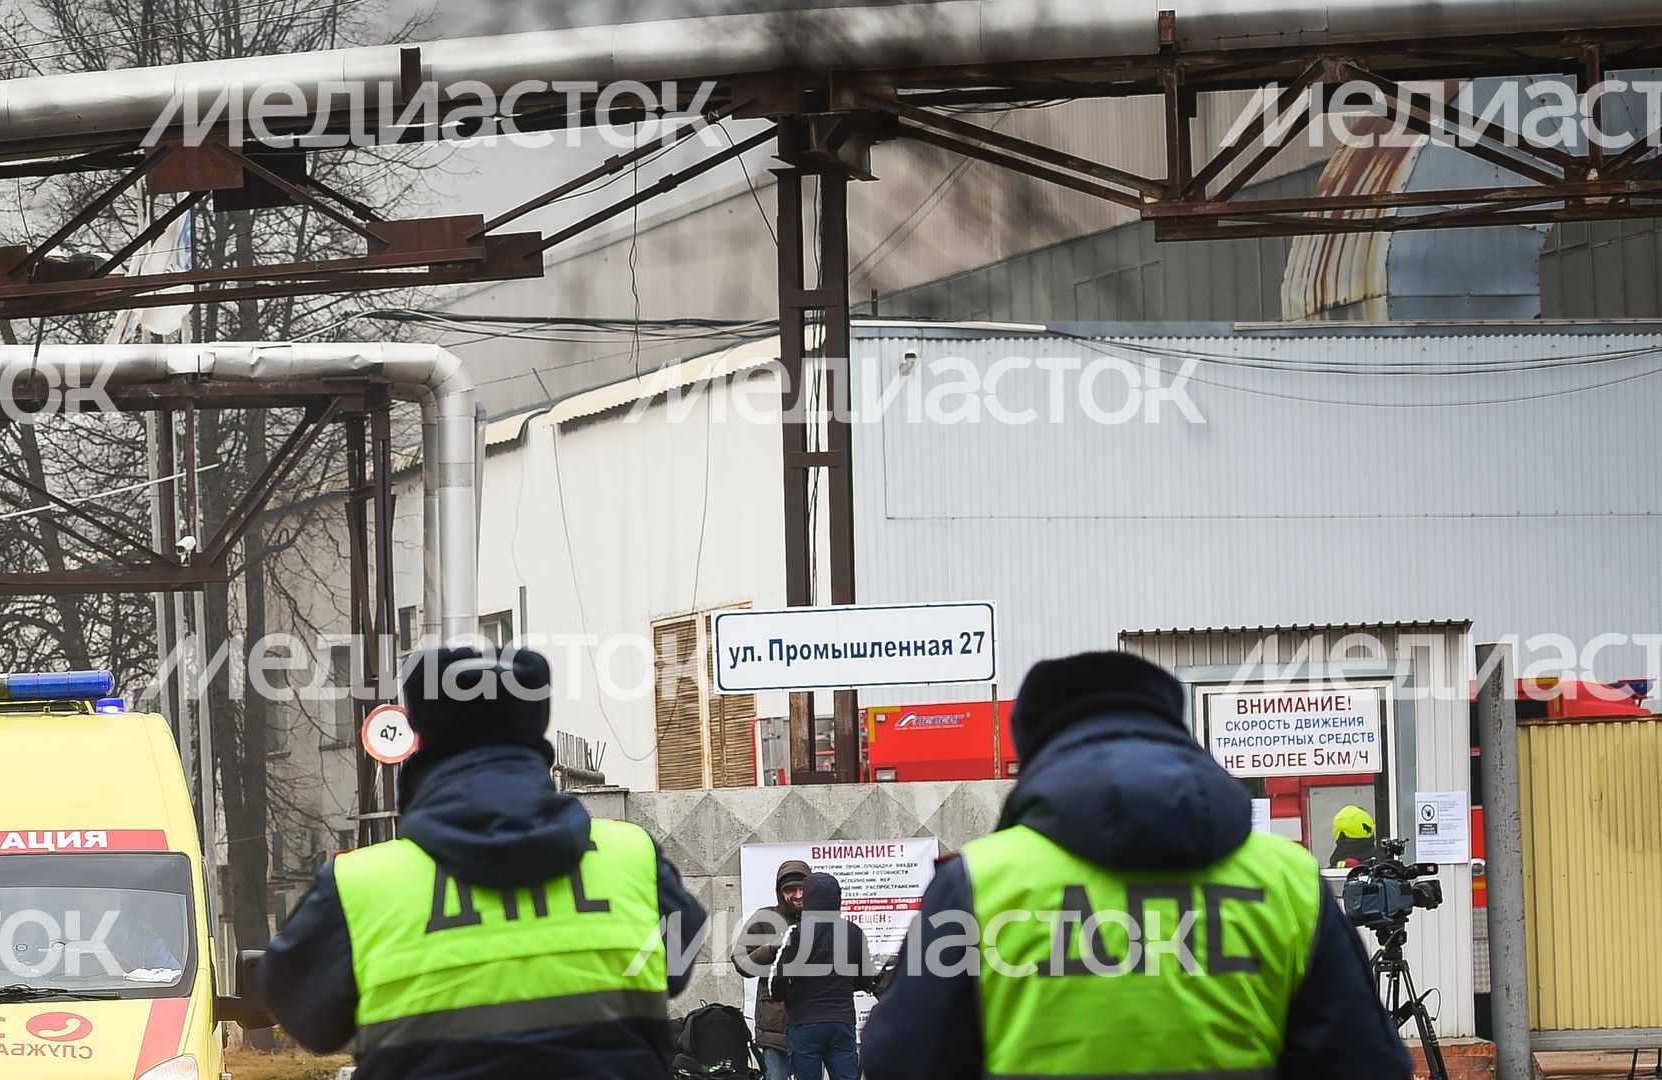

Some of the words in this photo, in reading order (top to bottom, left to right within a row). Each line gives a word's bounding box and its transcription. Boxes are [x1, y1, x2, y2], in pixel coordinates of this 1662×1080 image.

[728, 645, 762, 669] ул.
[768, 637, 953, 667] Промышленная
[959, 631, 986, 654] 27
[1236, 695, 1352, 715] ВНИМАНИЕ!
[1225, 718, 1291, 732] СКОРОСТЬ
[1295, 716, 1364, 731] ДВИЖЕНИЯ
[1216, 735, 1314, 748] ТРАНСПОРТНЫХ
[1318, 732, 1375, 746] СРЕДСТВ
[1224, 755, 1245, 769] НЕ
[1251, 752, 1307, 768] БОЛЕЕ
[1313, 748, 1369, 768] 5КМ/Ч
[811, 844, 905, 860] ВНИМАНИЕ!
[845, 914, 891, 924] ПРЕЩЕН:
